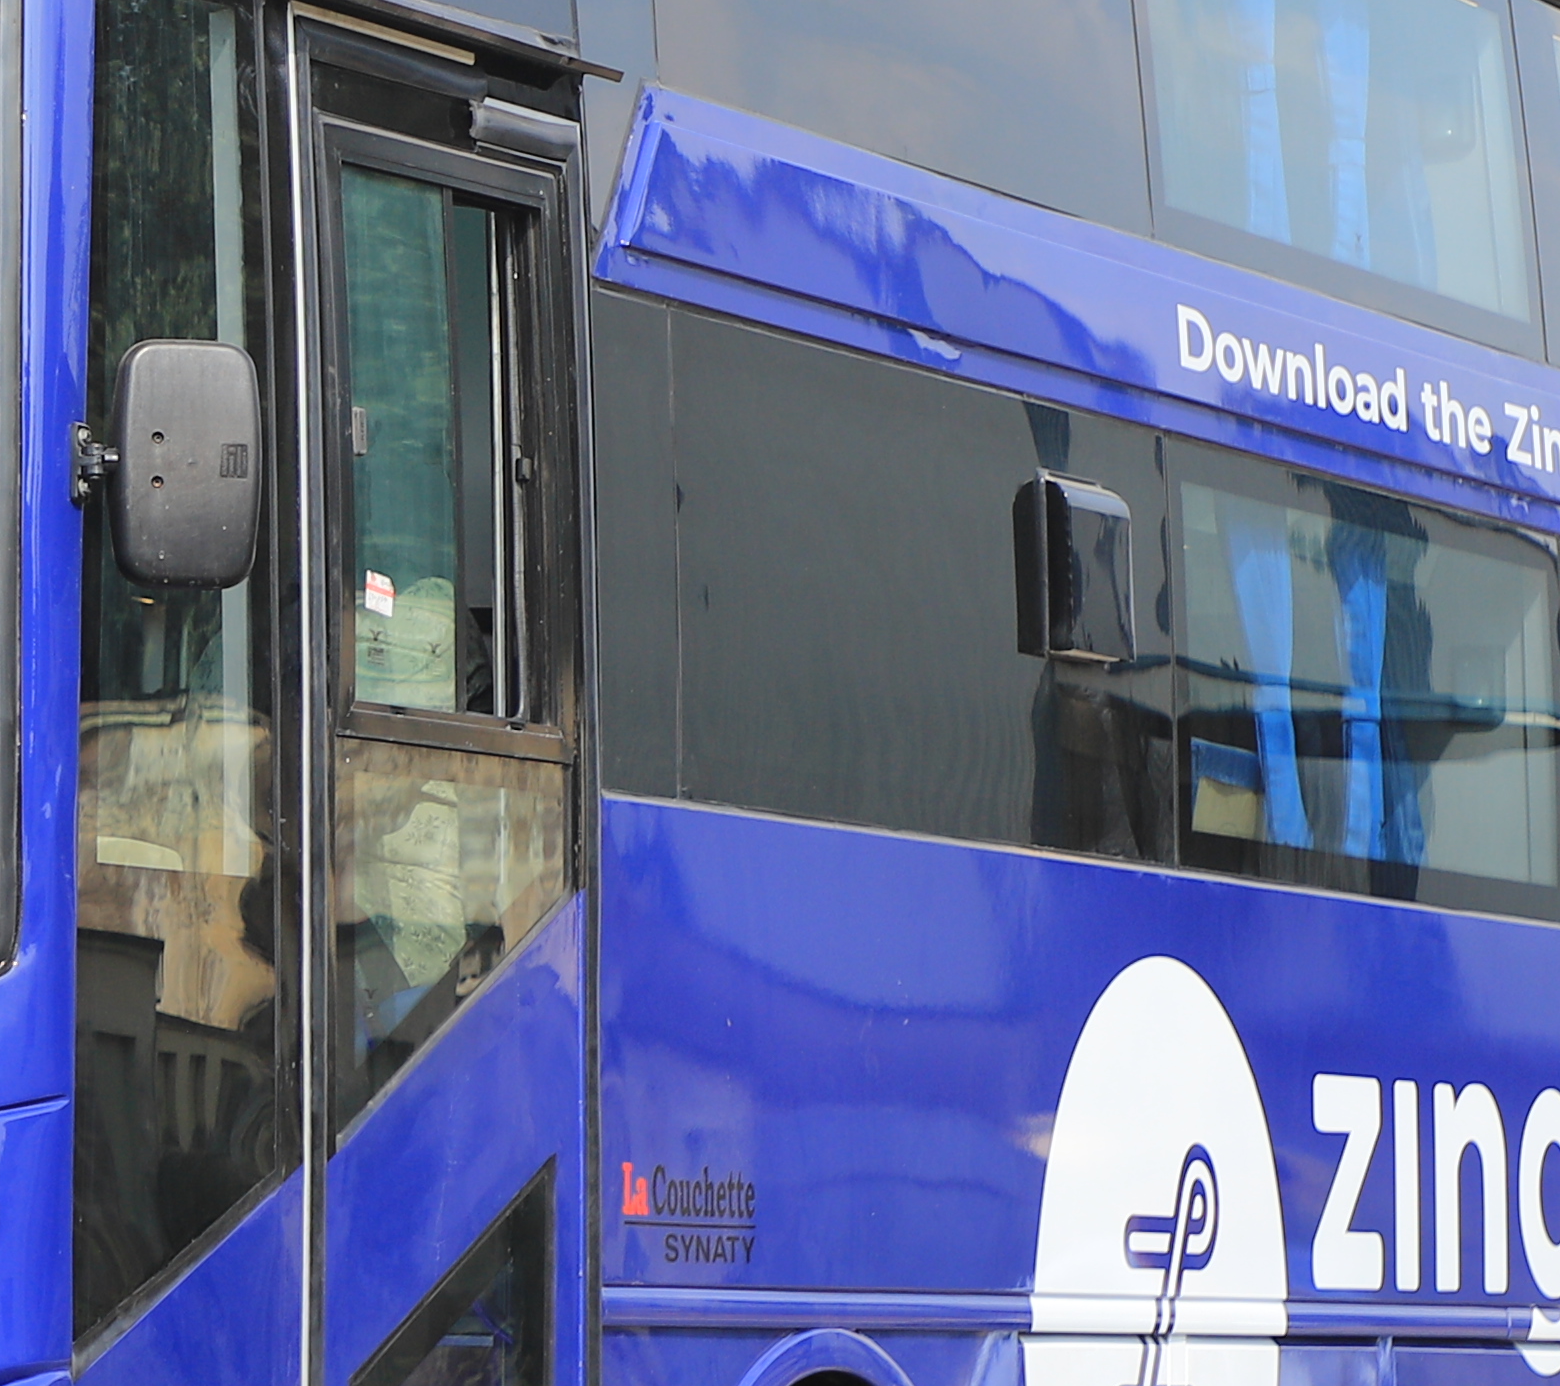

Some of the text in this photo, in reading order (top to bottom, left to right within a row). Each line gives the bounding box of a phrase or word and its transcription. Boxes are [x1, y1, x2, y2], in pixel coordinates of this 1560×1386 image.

[1176, 303, 1409, 433] Download
[1420, 379, 1493, 455] the
[652, 1164, 756, 1220] Couchette
[664, 1233, 756, 1264] SYNATY
